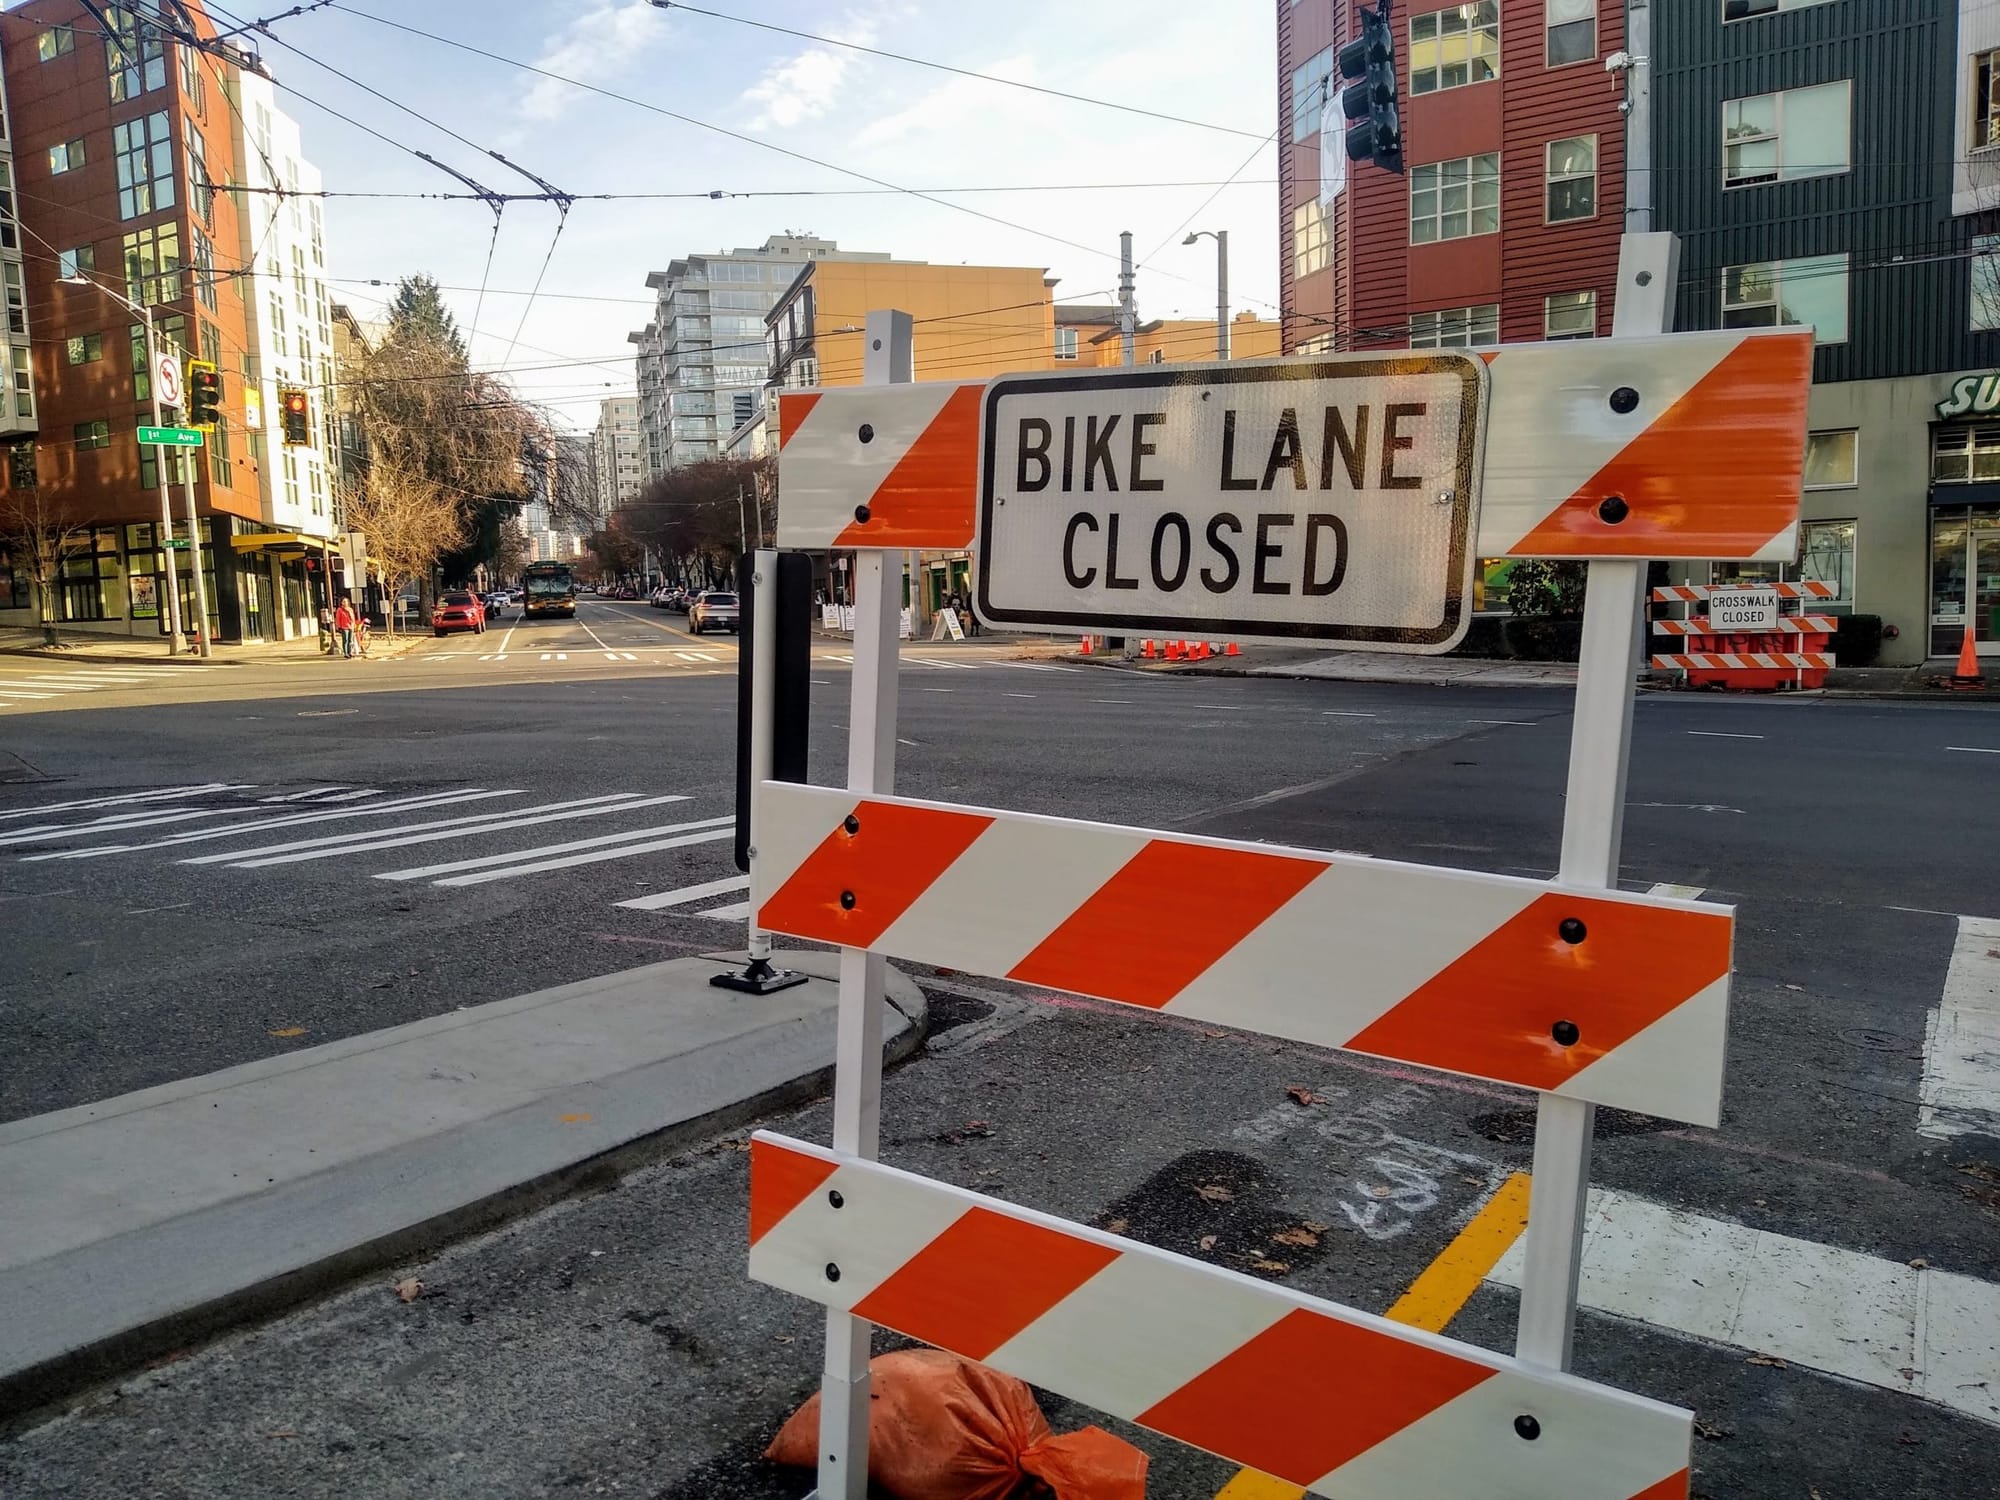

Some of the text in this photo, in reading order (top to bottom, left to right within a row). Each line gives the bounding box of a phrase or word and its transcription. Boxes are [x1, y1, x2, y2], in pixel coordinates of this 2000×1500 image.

[148, 430, 195, 441] 1st Ave
[1016, 402, 1427, 492] BIKE LANE
[1062, 511, 1348, 596] CLOSED
[1712, 595, 1775, 608] CROSSWALK
[1722, 611, 1764, 623] CLOSED
